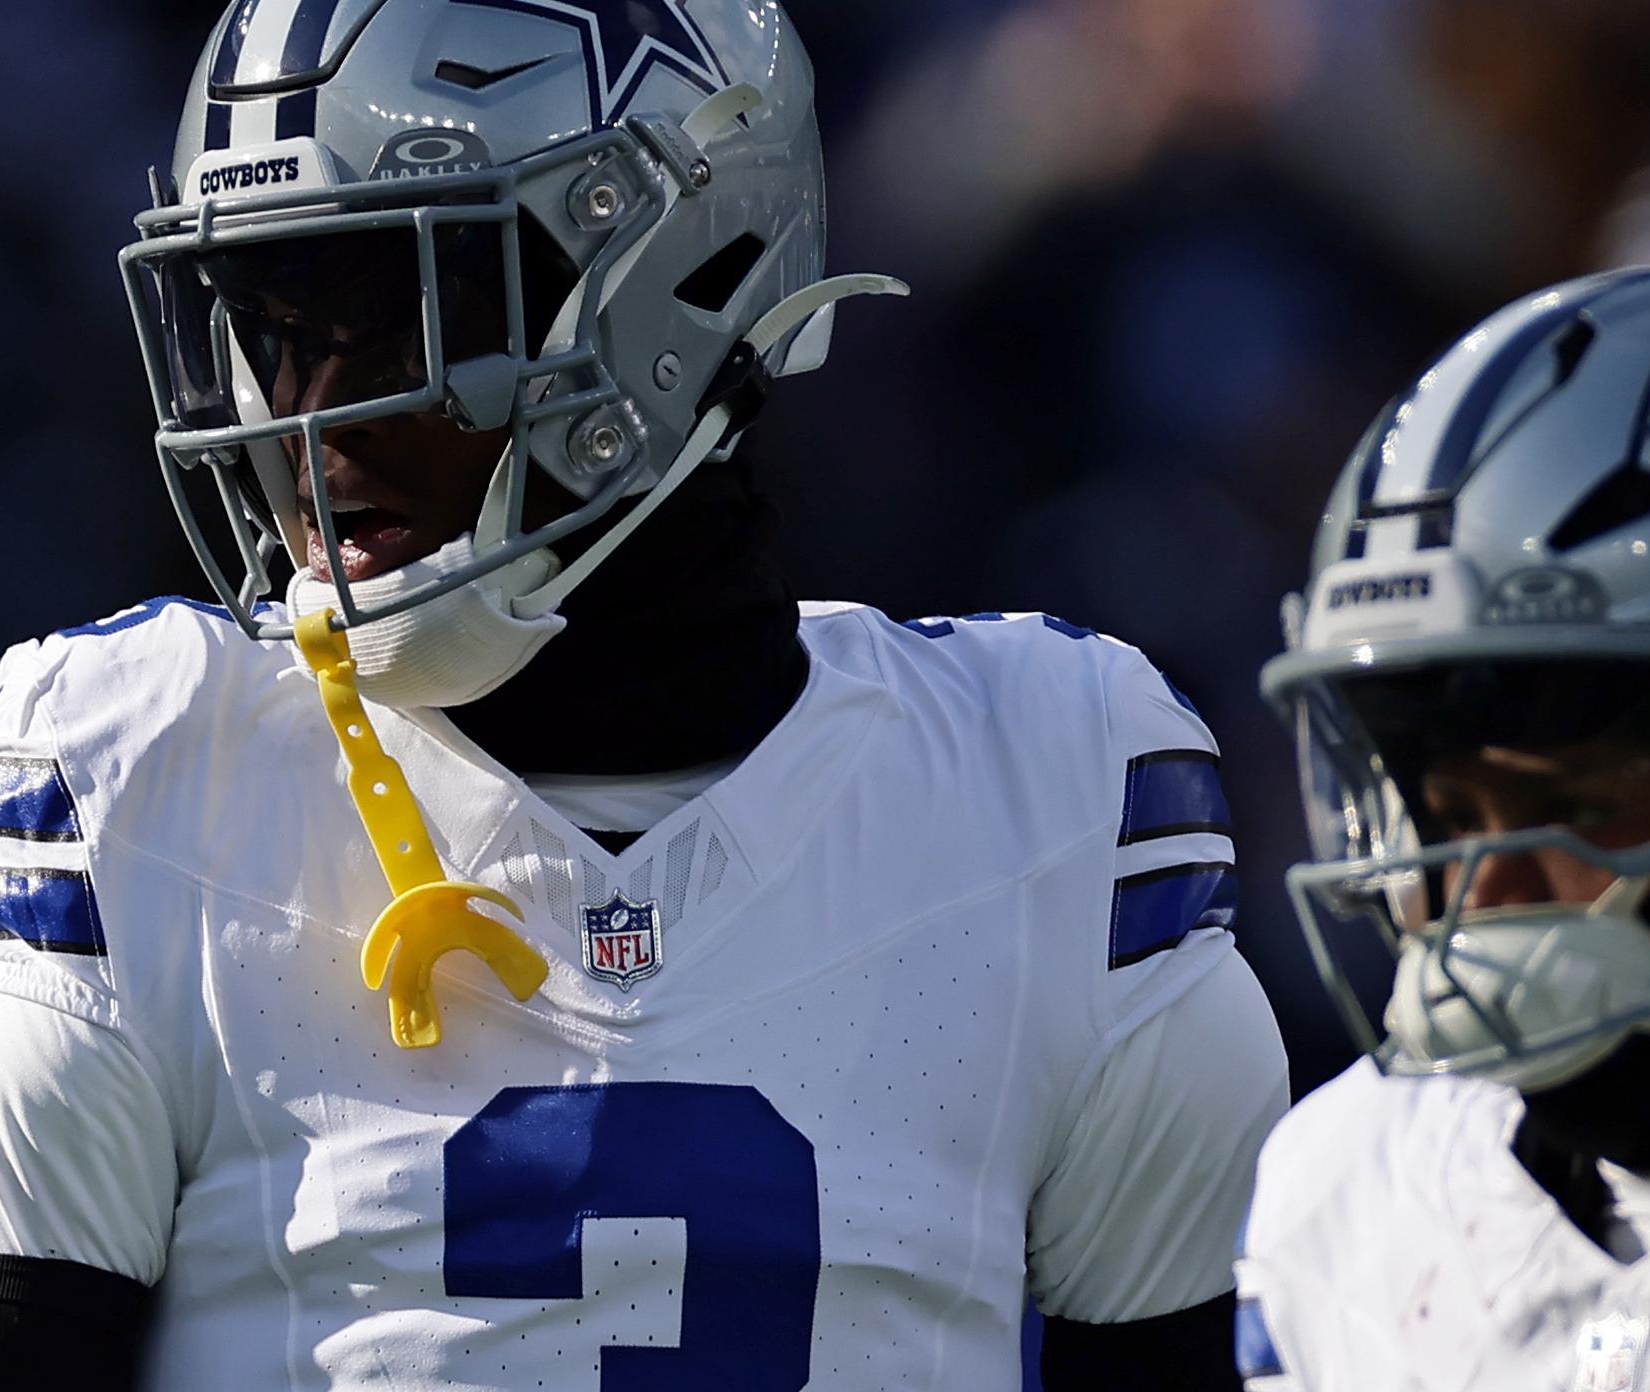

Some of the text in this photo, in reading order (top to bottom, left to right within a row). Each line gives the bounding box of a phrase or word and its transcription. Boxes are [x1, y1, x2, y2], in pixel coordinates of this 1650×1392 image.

[200, 157, 299, 196] COWBOYS
[380, 161, 481, 181] OAKLEY
[594, 933, 650, 972] NFL
